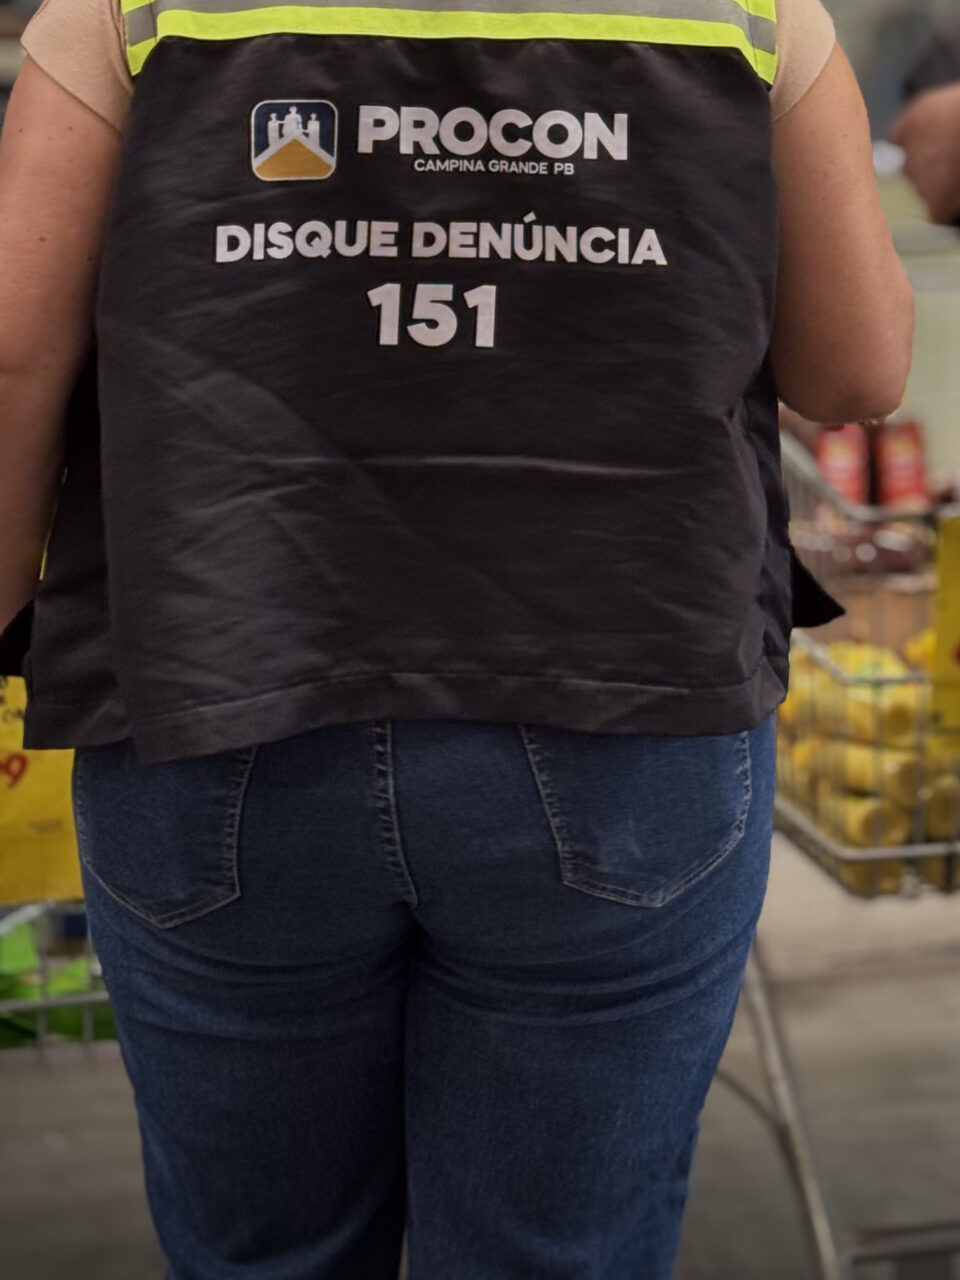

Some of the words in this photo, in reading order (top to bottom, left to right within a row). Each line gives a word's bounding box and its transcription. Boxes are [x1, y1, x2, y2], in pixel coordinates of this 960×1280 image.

[357, 105, 628, 161] PROCON
[414, 158, 485, 172] CAMPINA
[488, 160, 548, 175] GRANDE
[553, 162, 575, 175] PB
[215, 220, 398, 263] DISQUE
[411, 212, 668, 266] DENÚNCIA
[367, 283, 497, 349] 151
